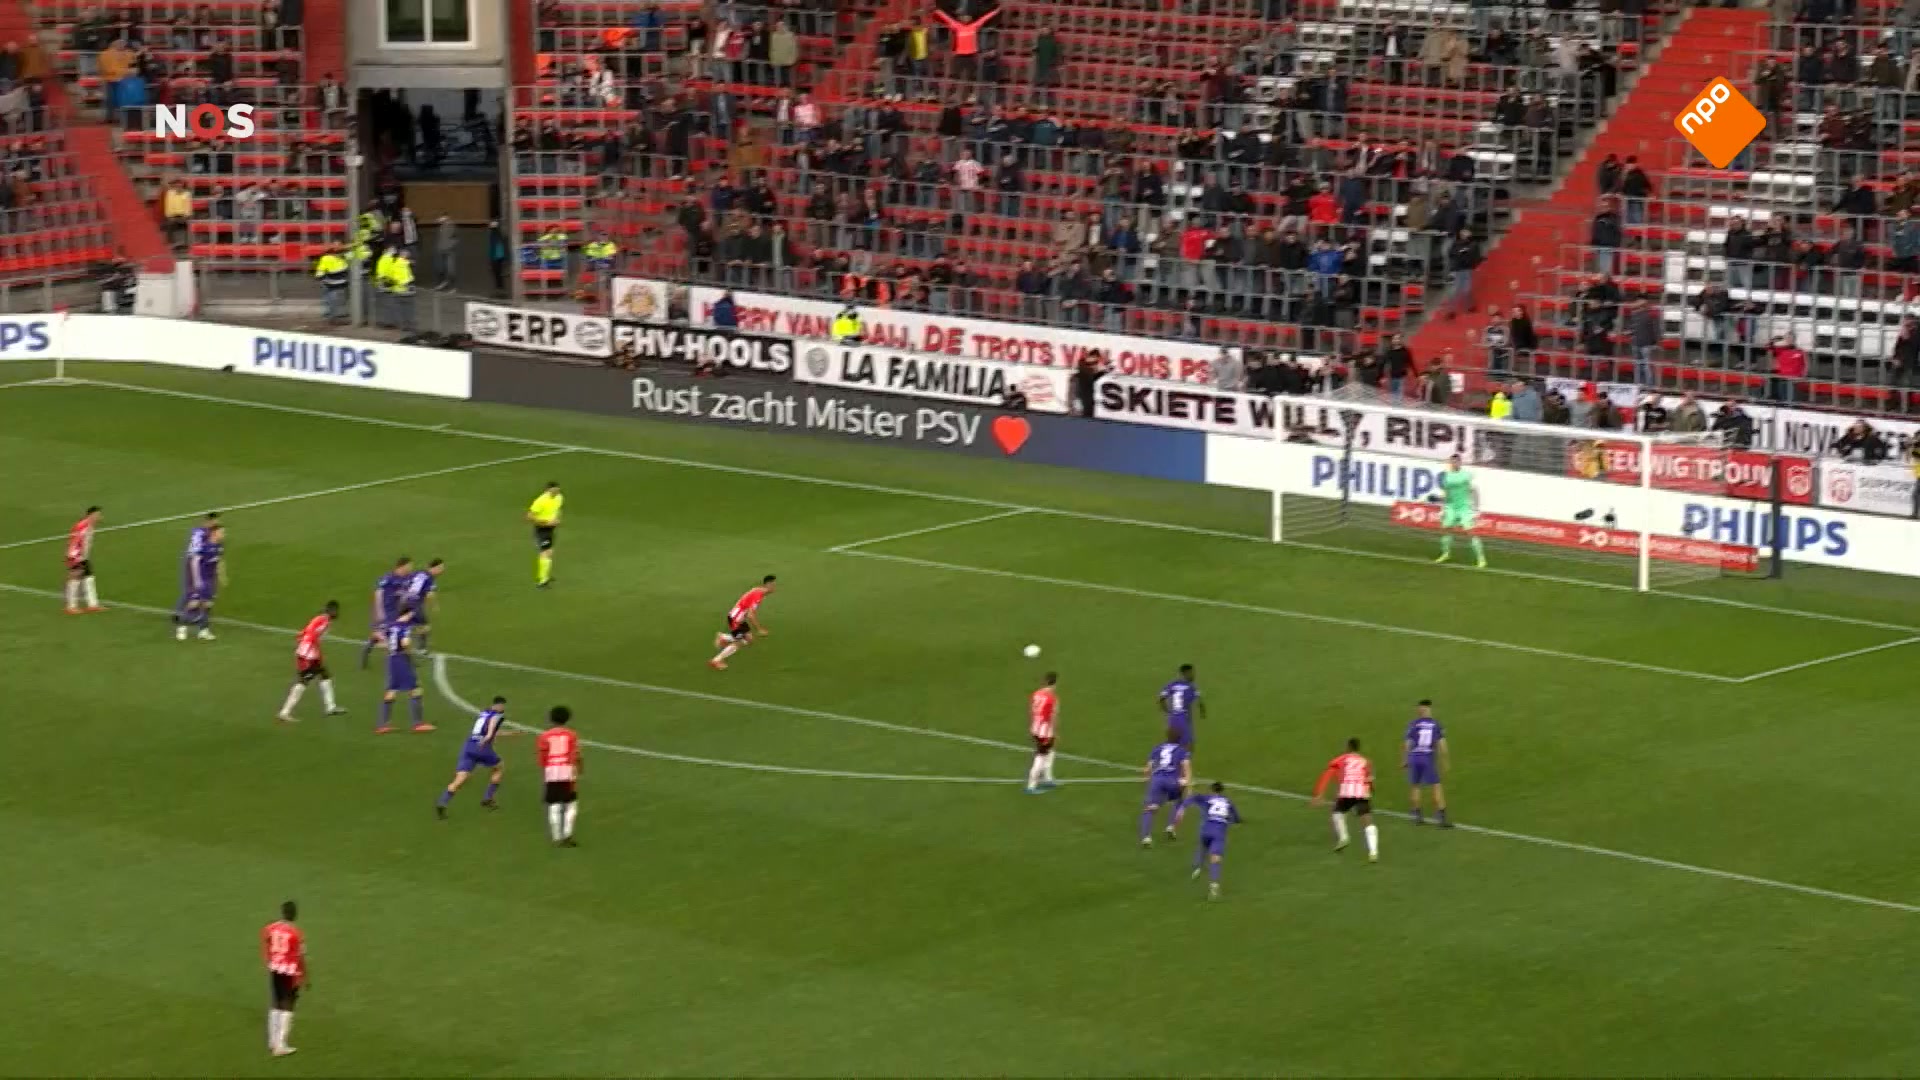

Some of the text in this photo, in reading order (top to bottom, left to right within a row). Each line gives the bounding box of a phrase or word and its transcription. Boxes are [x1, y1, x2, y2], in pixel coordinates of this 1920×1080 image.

[506, 312, 568, 346] ERP
[923, 325, 965, 356] DE
[972, 333, 1053, 366] TROTS
[254, 336, 377, 379] PHILIPS
[841, 351, 1006, 398] LA FAMILIA
[632, 376, 982, 446] Rust zacht Mister PSV
[1101, 382, 1237, 425] SKIETE
[1385, 416, 1466, 451] RIP!
[1684, 502, 1848, 557] PHILIPS
